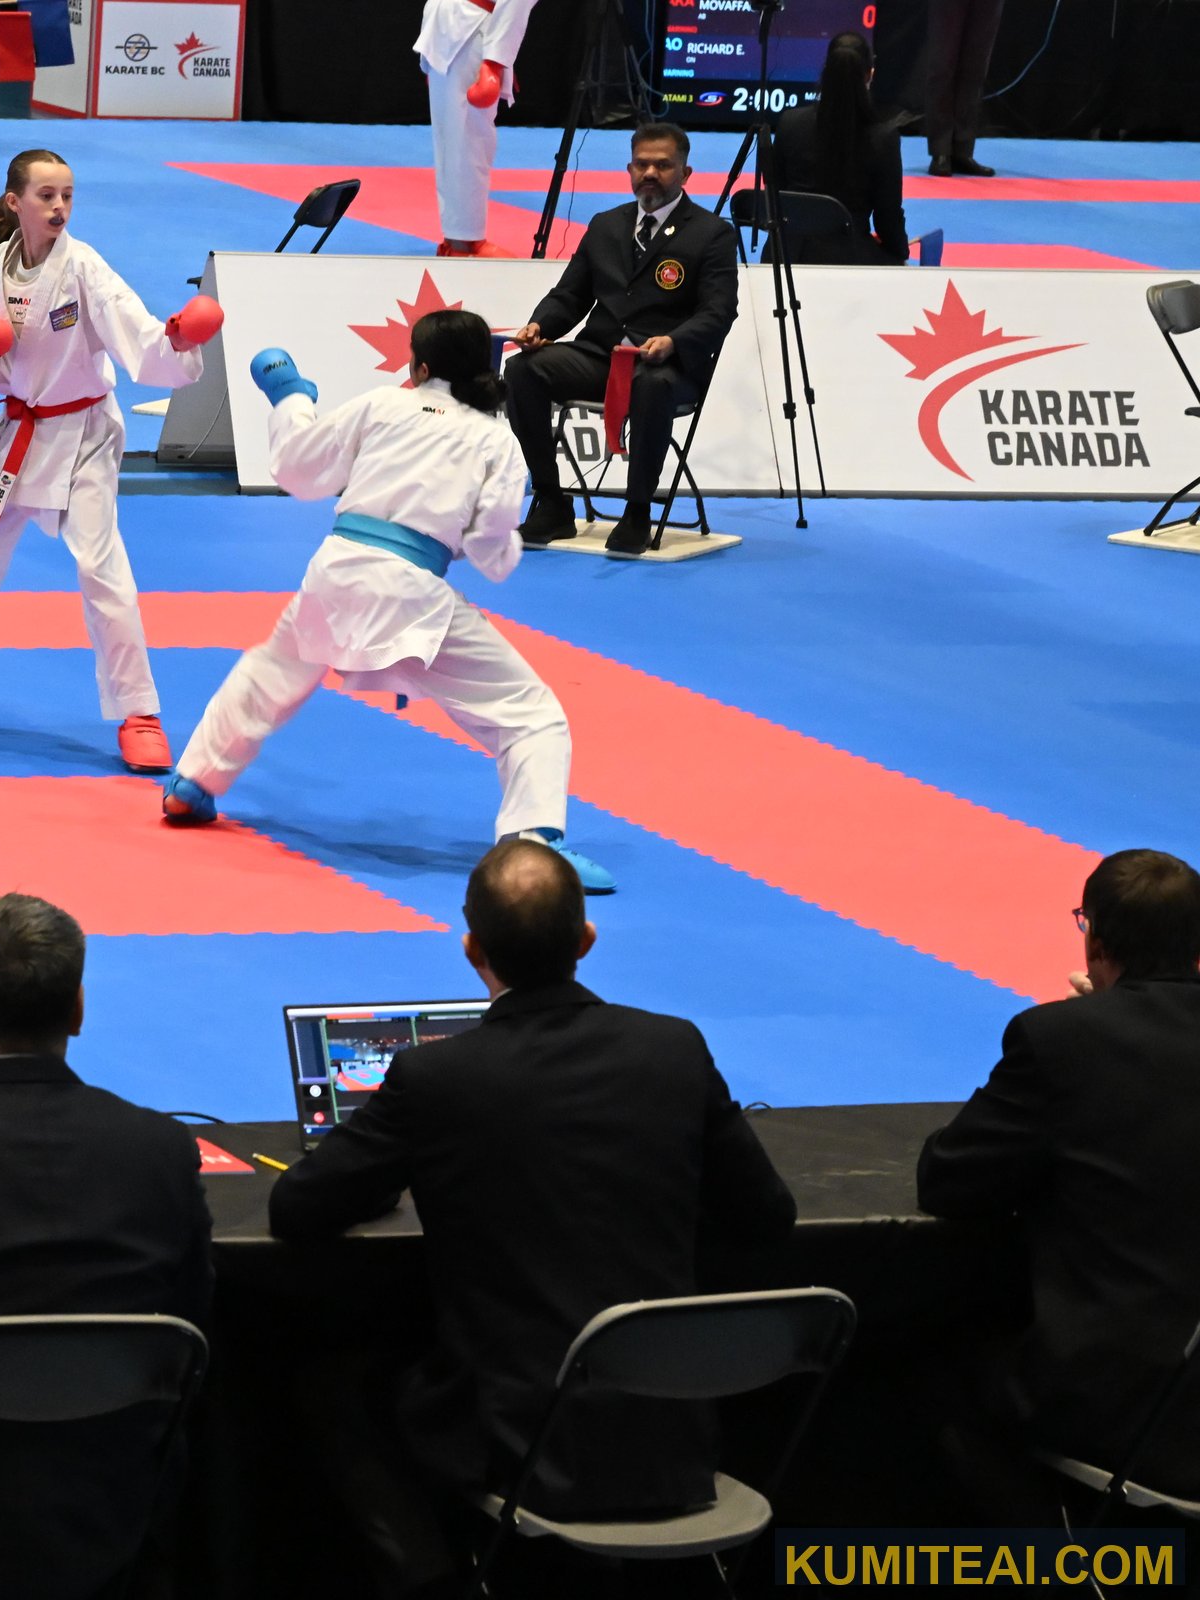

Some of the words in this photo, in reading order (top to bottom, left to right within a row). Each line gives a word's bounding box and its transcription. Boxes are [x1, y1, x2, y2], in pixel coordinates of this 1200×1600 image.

[862, 5, 877, 29] 0
[687, 42, 734, 55] RICHARD
[193, 57, 231, 67] KARATE
[105, 65, 148, 75] KARATE
[151, 66, 165, 76] BC
[193, 69, 231, 78] CANADA
[8, 296, 31, 305] SMAI
[978, 389, 1140, 426] KARATE
[987, 431, 1151, 467] CANADA
